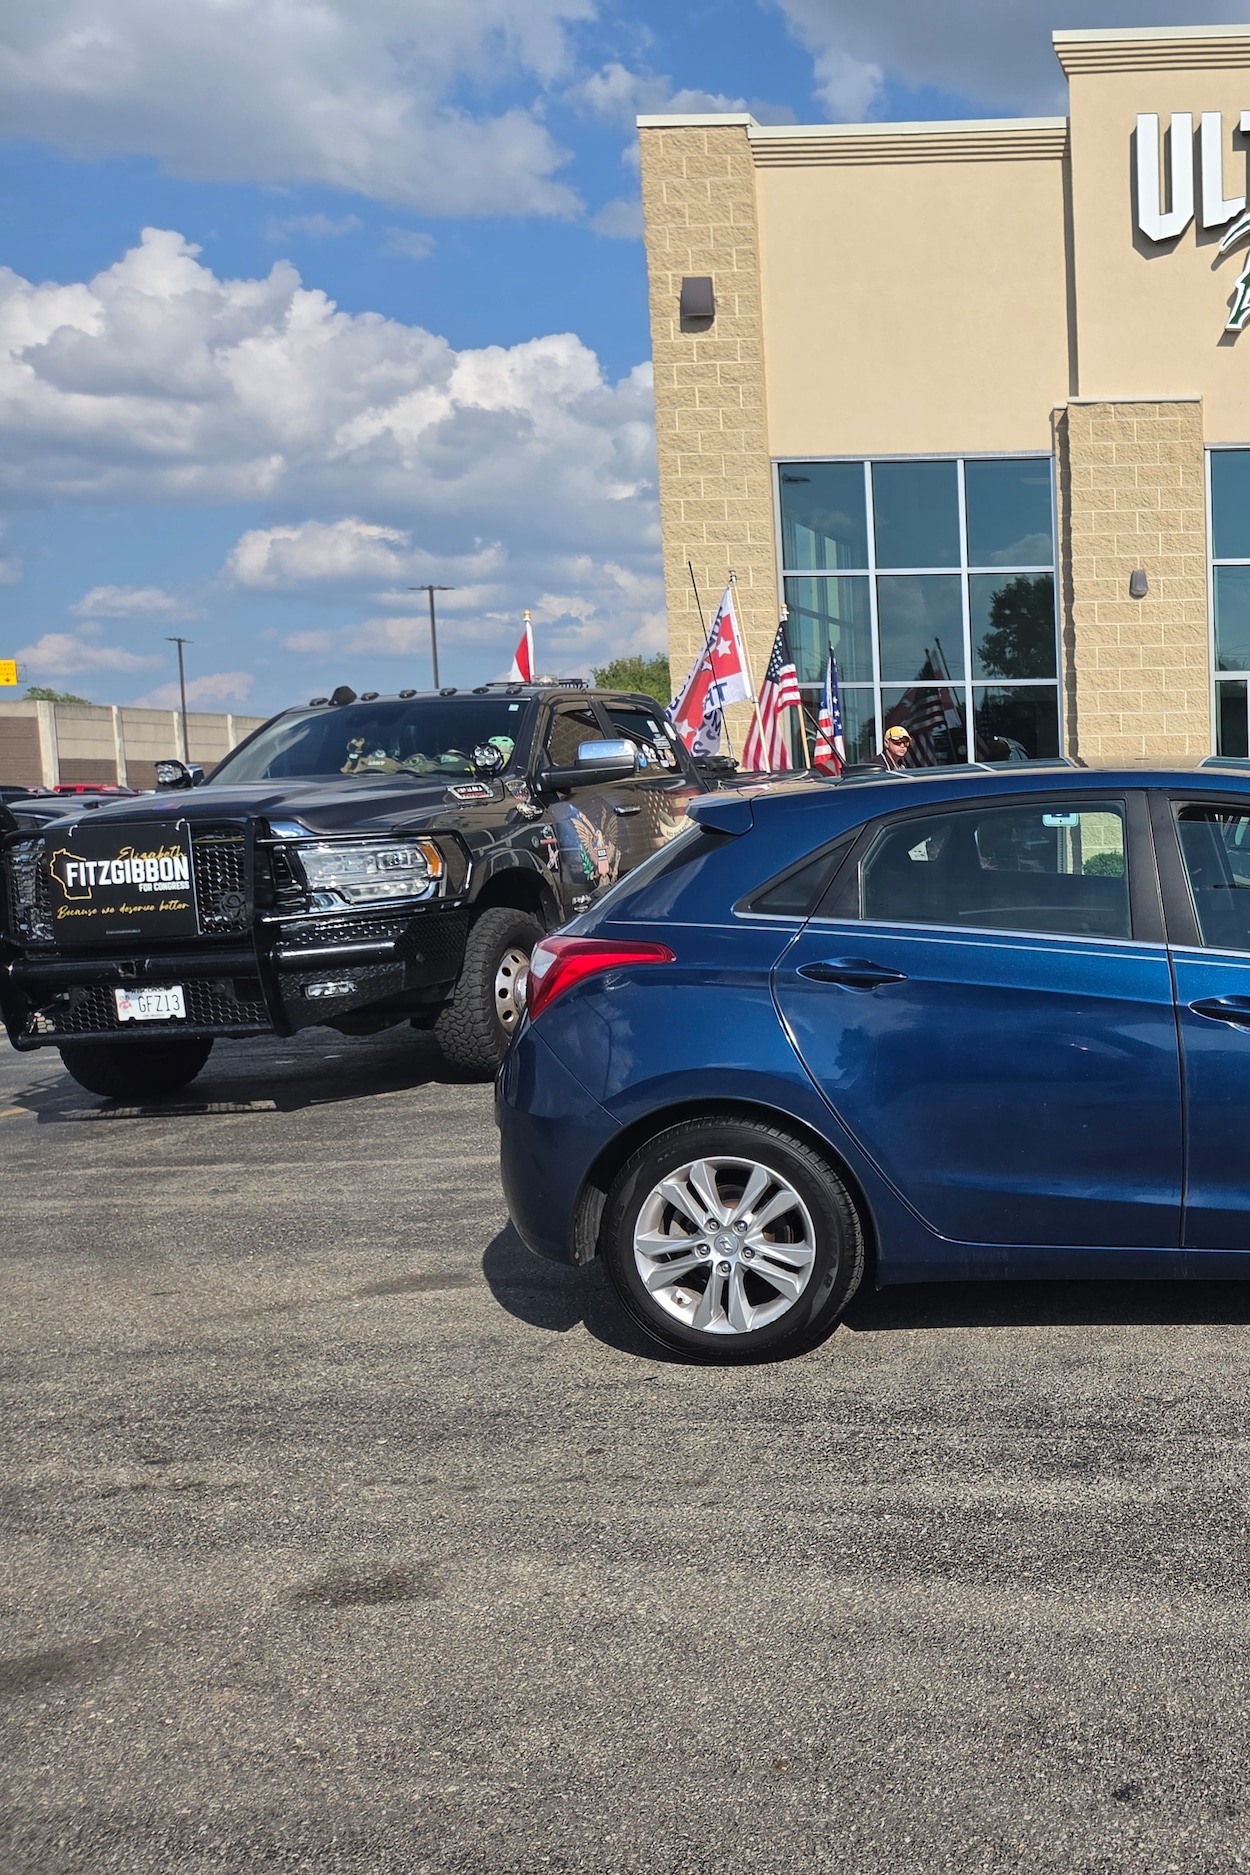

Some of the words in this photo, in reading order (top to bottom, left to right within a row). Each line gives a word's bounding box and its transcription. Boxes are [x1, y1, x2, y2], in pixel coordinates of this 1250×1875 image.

[117, 845, 187, 861] Elizabeth
[66, 856, 190, 888] FITZGIBBON
[139, 882, 153, 893] FOR
[153, 881, 190, 892] CONGRESS
[56, 905, 98, 920] Because
[101, 906, 115, 915] we
[119, 903, 155, 915] deserve
[159, 899, 190, 911] better
[138, 994, 181, 1013] GFZ13
